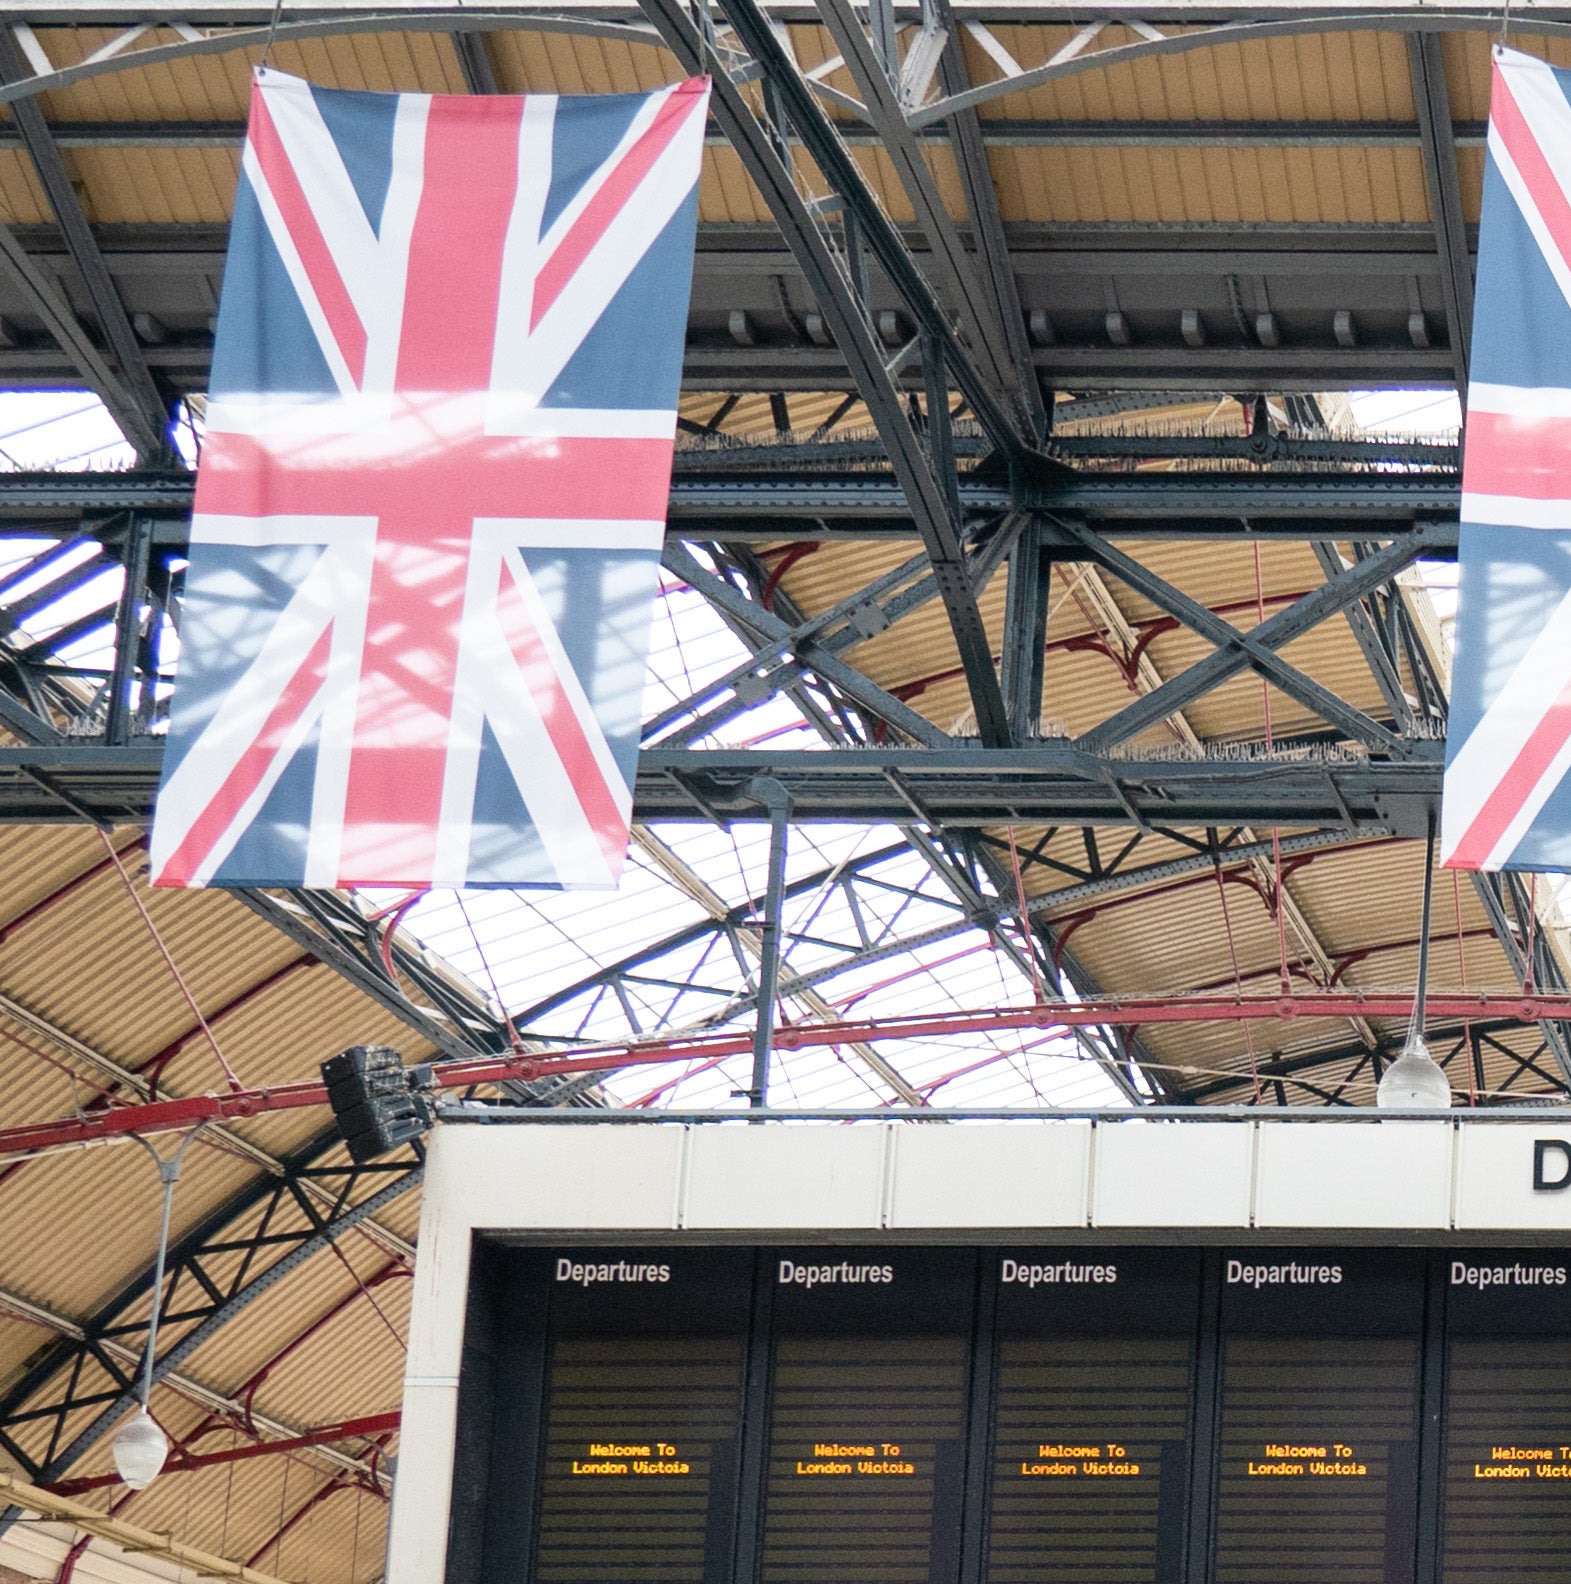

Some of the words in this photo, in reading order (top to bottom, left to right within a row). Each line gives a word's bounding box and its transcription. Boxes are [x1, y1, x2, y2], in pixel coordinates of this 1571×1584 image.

[557, 1259, 669, 1286] Departures
[1452, 1262, 1566, 1289] Departures
[589, 1443, 652, 1457] Welcome
[656, 1442, 677, 1457] To
[572, 1461, 629, 1475] London
